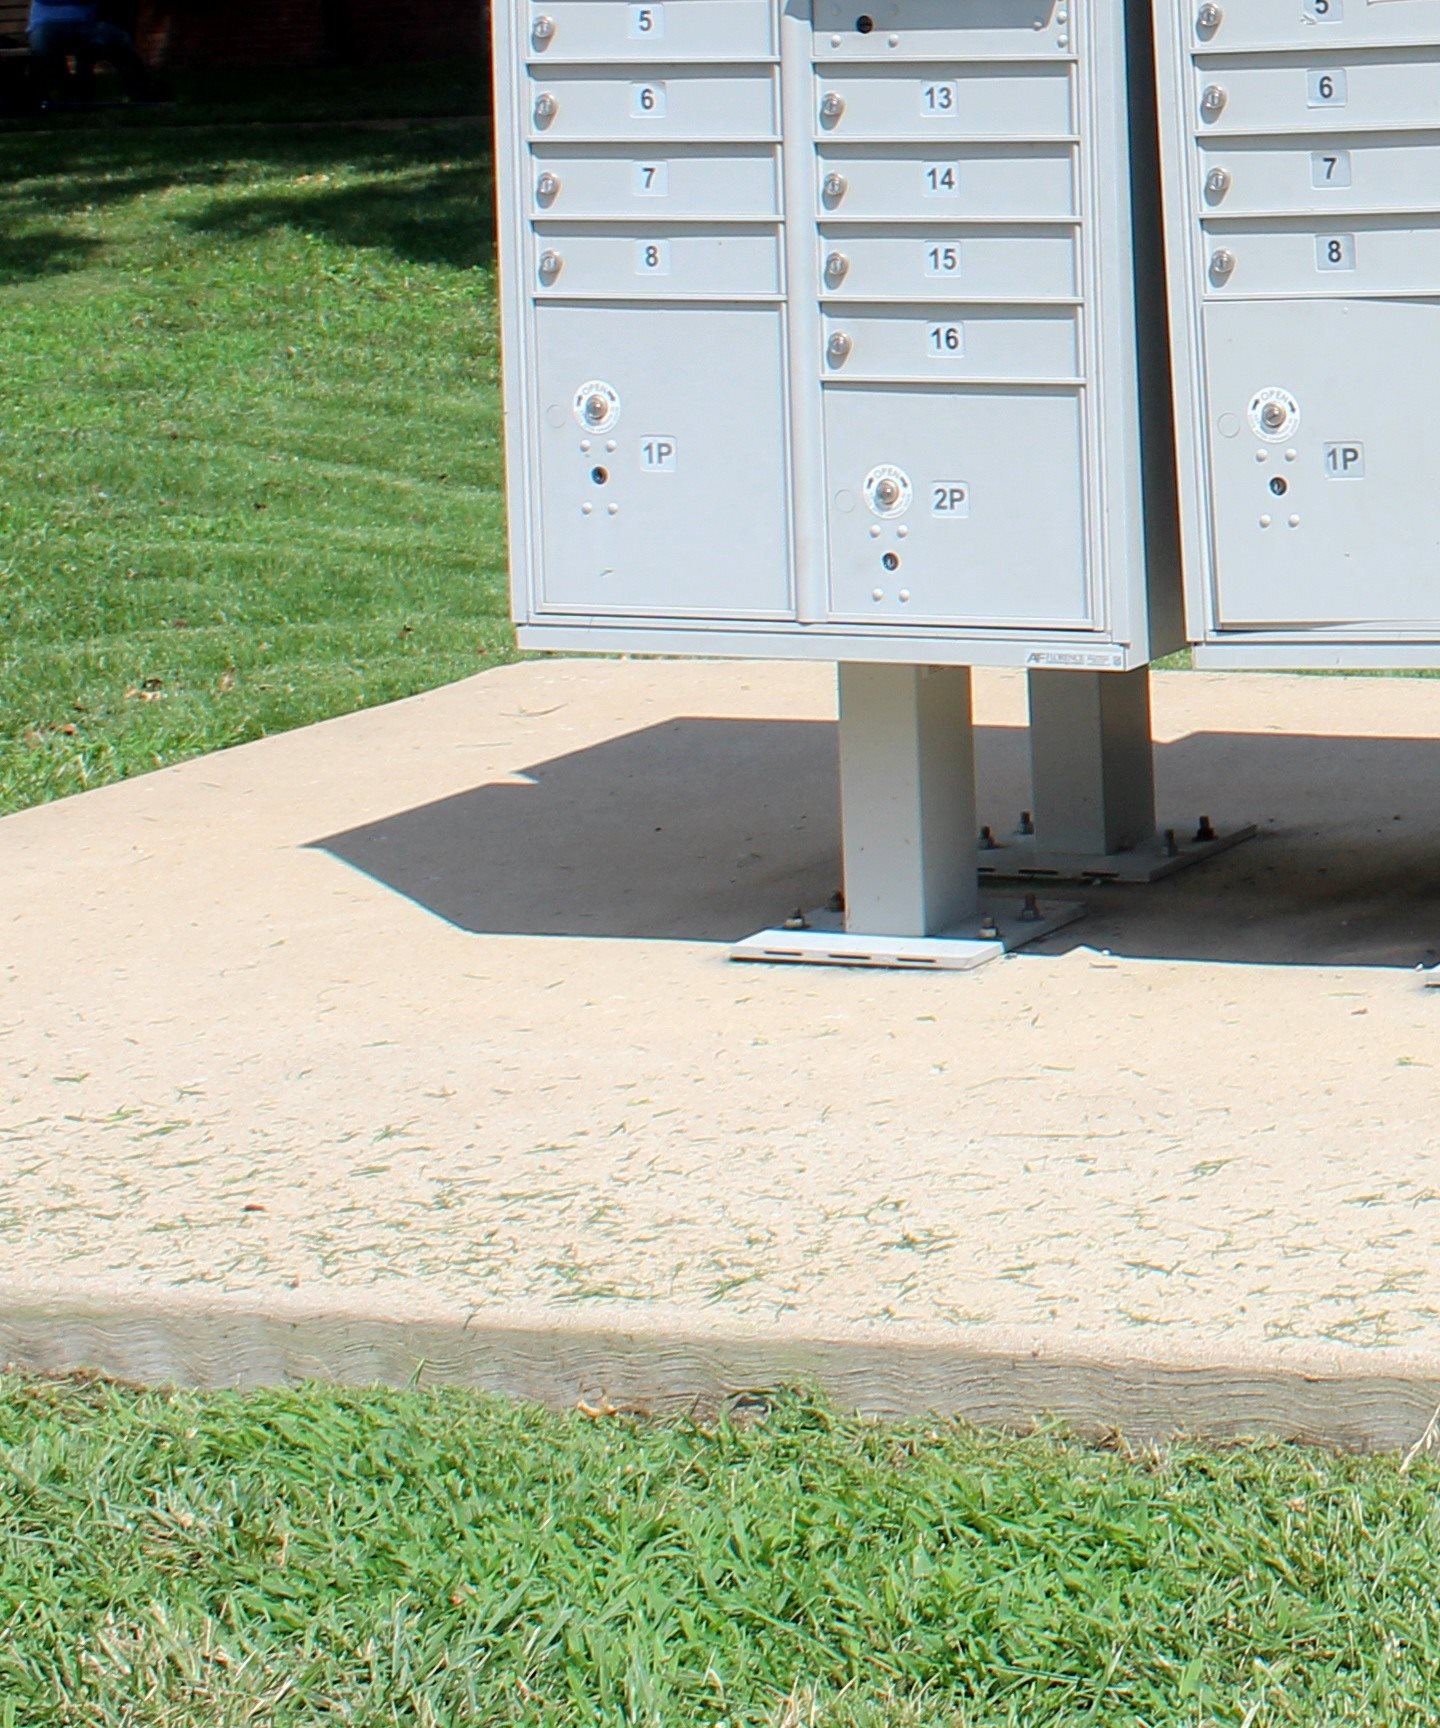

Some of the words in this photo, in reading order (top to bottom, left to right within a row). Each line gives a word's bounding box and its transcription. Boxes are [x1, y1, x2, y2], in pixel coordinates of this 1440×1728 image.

[639, 10, 652, 32] 5
[924, 86, 952, 109] 13
[1319, 75, 1333, 99] 6
[640, 88, 654, 110] 6
[642, 167, 655, 188] 7
[926, 168, 954, 190] 14
[1322, 157, 1337, 180] 7
[645, 245, 658, 268] 8
[928, 248, 956, 270] 15
[1328, 240, 1342, 263] 8
[930, 327, 959, 350] 16
[1260, 390, 1289, 403] OPEN
[642, 442, 672, 464] 1P
[1326, 447, 1359, 470] 1P
[873, 468, 899, 480] OPEN
[933, 488, 965, 510] 2P
